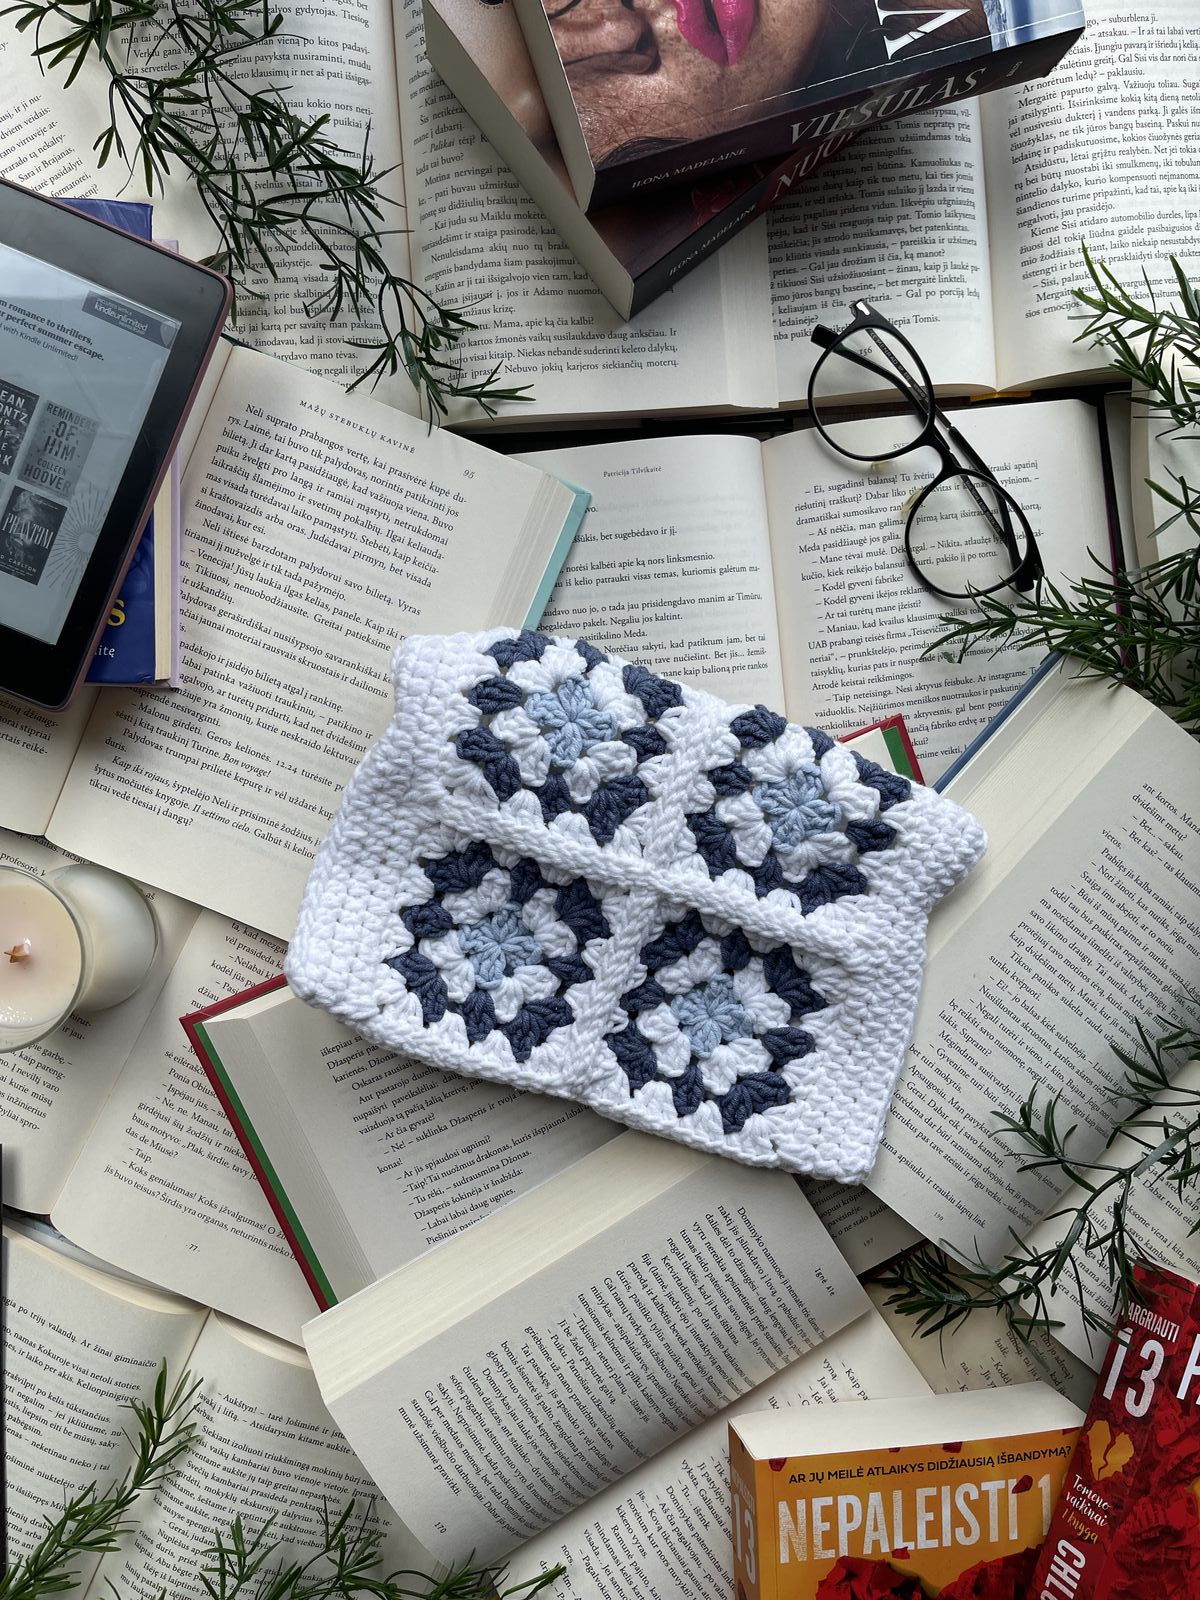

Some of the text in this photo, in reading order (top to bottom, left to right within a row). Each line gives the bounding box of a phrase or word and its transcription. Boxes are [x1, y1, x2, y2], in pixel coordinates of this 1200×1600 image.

[254, 50, 371, 71] pavyksta nusiraminti, mudu
[790, 68, 987, 144] VIESULAS
[17, 147, 75, 183] Sara ir Brajanas,
[631, 147, 748, 189] ILONA MADELAINE
[1023, 144, 1197, 174] Atsidūstu, lėtai grįžtu realybėn. Net jei tokia
[1017, 201, 1115, 229] negalvoti, jau prasidėjo.
[2, 324, 79, 362] with Kindle Unlimited!
[4, 313, 104, 361] perfect summer escape.
[7, 303, 93, 346] romance to thrillers,
[503, 359, 679, 374] Nebuvo jokių karjeros siekiančių moterų.
[46, 402, 98, 430] REMINDERS
[55, 421, 79, 441] OF
[299, 399, 415, 454] MAŽŲ STEBUKLŲ KAVINĖ
[36, 457, 67, 477] COLLEEN
[44, 435, 77, 462] HIM
[227, 415, 460, 518] rys. Laimė, tai buvo tik palydovas, norintis patikrinti jos
[245, 403, 466, 503] Neli suprato prabangos vertę, kai prasivėrė kupė du-
[24, 464, 72, 493] HOOVER
[565, 551, 715, 573] norėsi kalbėti apie ką nors linksmesnio.
[798, 542, 821, 554] Meda
[822, 535, 868, 552] pasidžiaugė
[868, 534, 881, 545] jos
[811, 679, 839, 691] Atrodė
[840, 676, 866, 688] keistai
[1080, 870, 1174, 956] Staiga imu abejoti, ar to noriu.
[938, 1009, 992, 1057] laikis. Supranti?
[908, 1042, 962, 1093] bet turi mokytis.
[124, 1126, 179, 1159] das de Miusė?
[103, 1165, 290, 1257] jis buvo teisus? Širdis yra organas, neturintis nieko
[413, 1200, 451, 1220] Džasperis
[450, 1186, 483, 1204] šokinėja
[489, 1168, 524, 1187] šnabžda:
[666, 1237, 686, 1261] negali
[697, 1283, 712, 1301] kad
[704, 1299, 716, 1307] ji
[710, 1303, 723, 1320] bus
[13, 1332, 141, 1391] namas Kokuroje visai netoli stoties.
[1102, 1327, 1165, 1418] 13
[201, 1424, 231, 1446] Siekiant
[230, 1439, 264, 1457] izoliuoti
[263, 1452, 310, 1472] triukšmingą
[310, 1465, 344, 1481] mokinių
[344, 1472, 361, 1486] būrį
[397, 1406, 462, 1497] munė užsimanė pravirkti.
[788, 1445, 1071, 1484] AR JŲ MEILĖ ATLAIKYS DIDŽIAUSIĄ IŠBANDYMĄ?
[1065, 1491, 1109, 1528] vaikinai
[1072, 1474, 1112, 1511] Tomeno
[733, 1493, 756, 1584] 13
[778, 1479, 1021, 1565] NEPALEISTI
[1067, 1511, 1099, 1545] knyga
